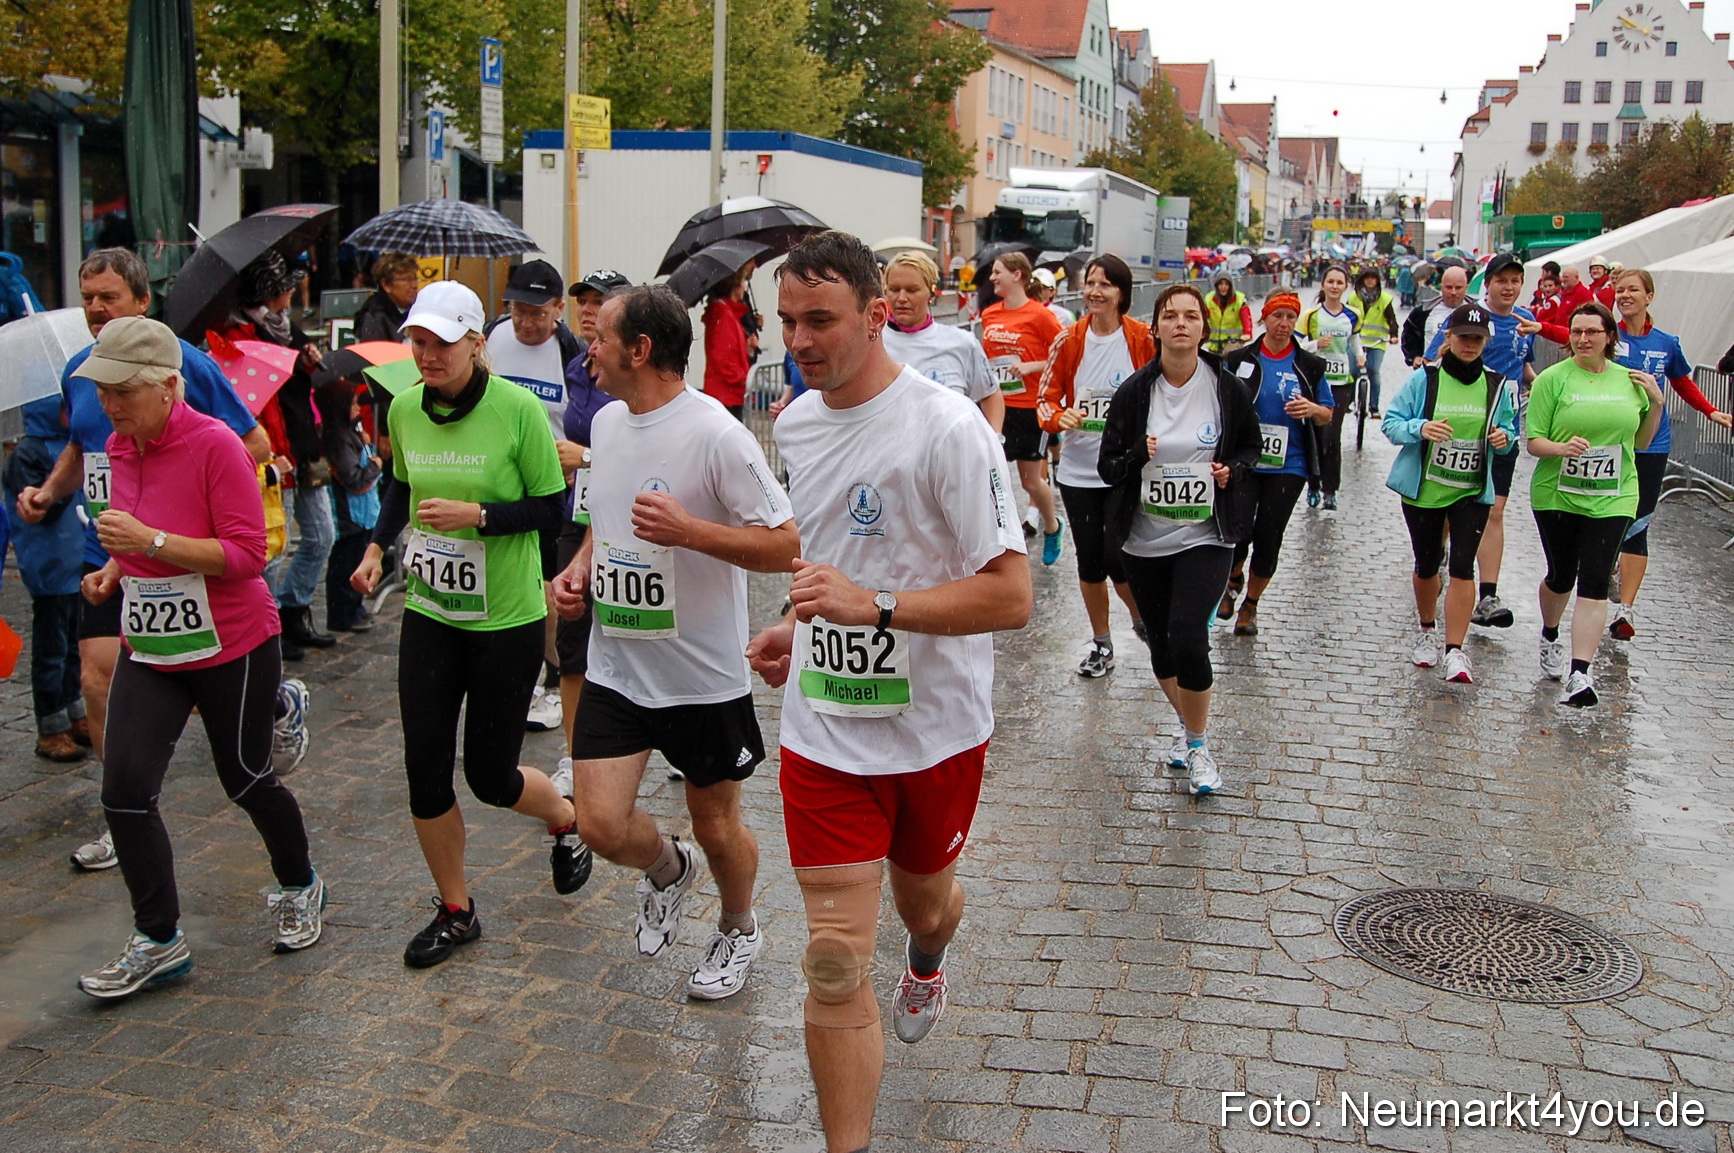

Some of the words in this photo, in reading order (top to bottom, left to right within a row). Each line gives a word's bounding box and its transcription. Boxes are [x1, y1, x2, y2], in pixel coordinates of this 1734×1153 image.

[1436, 447, 1480, 471] 5155
[1566, 458, 1615, 477] 5174
[1149, 480, 1207, 504] 5042
[411, 553, 476, 591] 5146
[138, 583, 173, 593] BOCK
[596, 564, 665, 606] 5106
[129, 599, 203, 634] 5228
[607, 610, 640, 626] Josef
[812, 625, 896, 674] 5052
[824, 680, 879, 700] Michael
